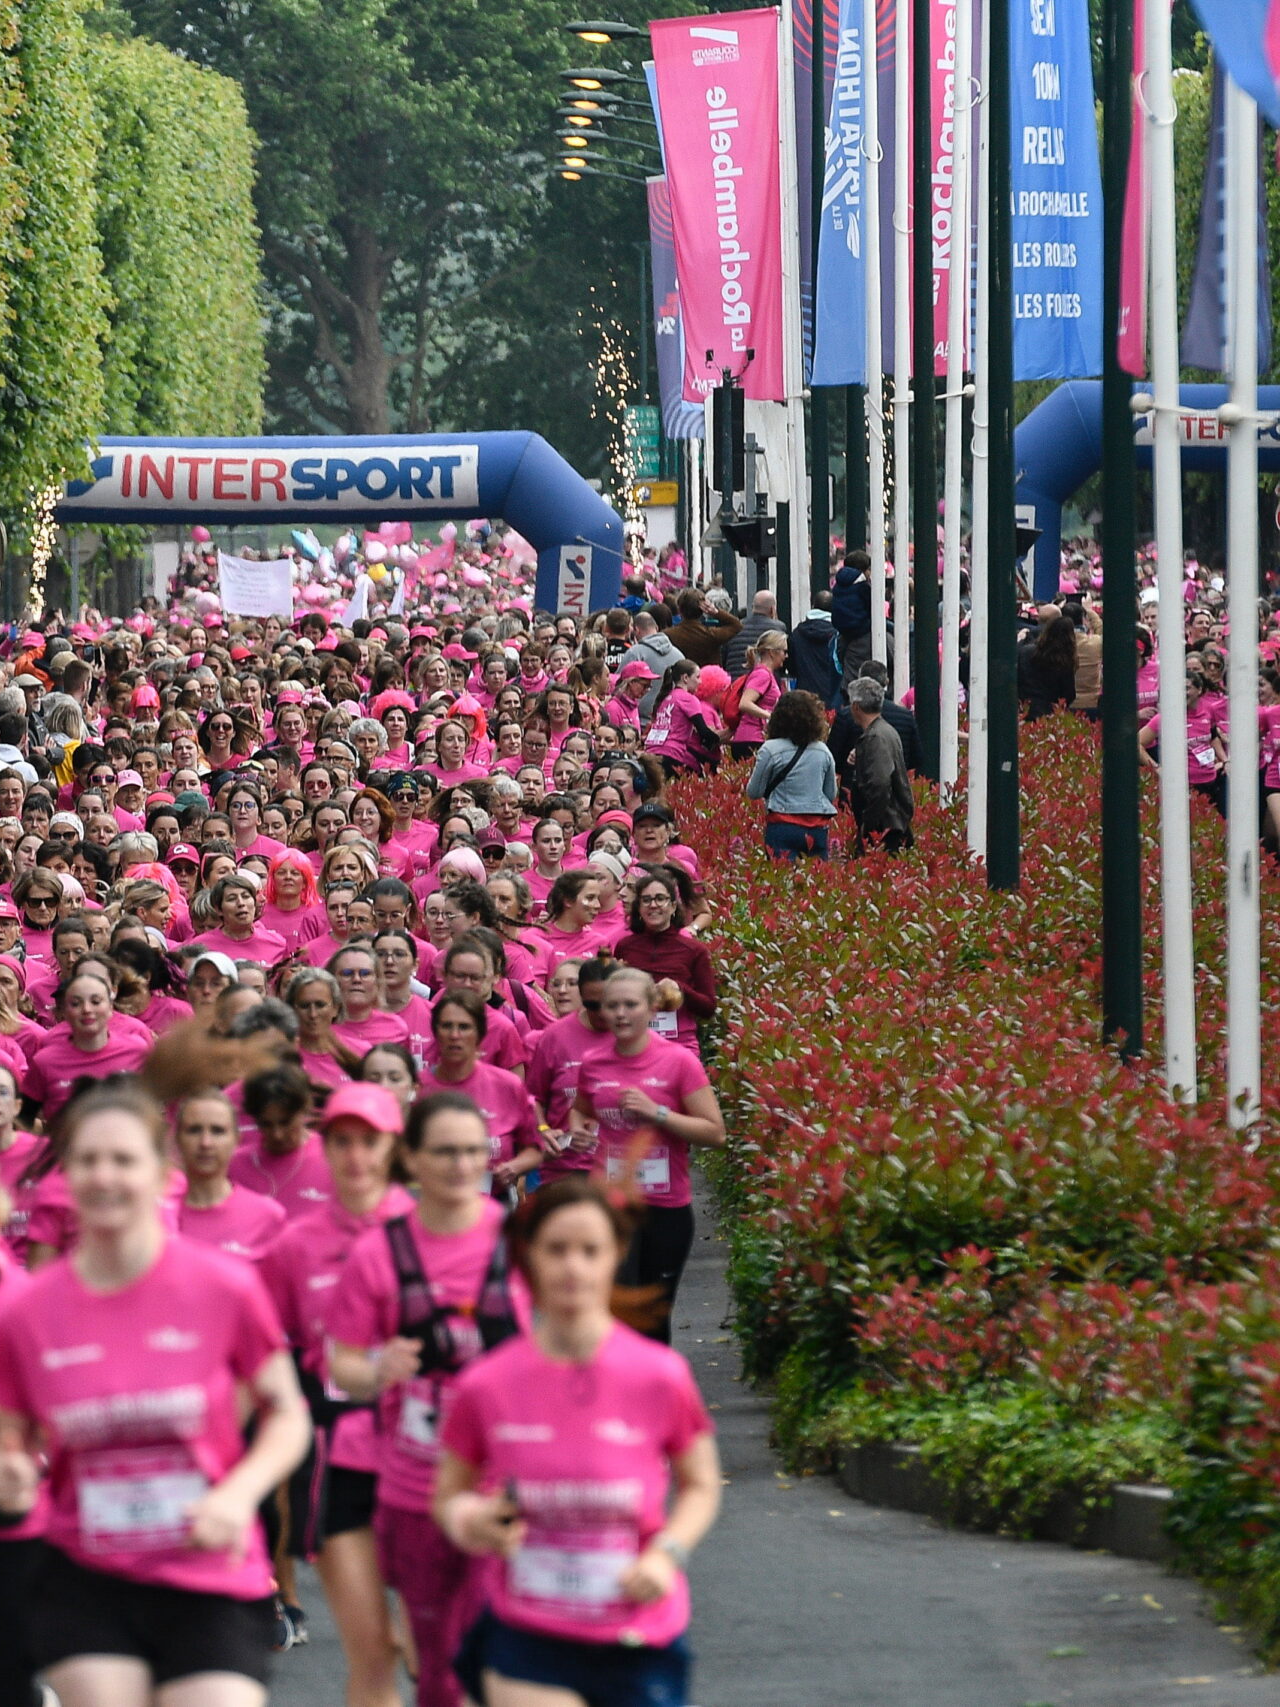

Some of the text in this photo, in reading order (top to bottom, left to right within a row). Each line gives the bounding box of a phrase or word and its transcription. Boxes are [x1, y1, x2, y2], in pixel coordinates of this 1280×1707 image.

[1013, 242, 1042, 268] LES
[1015, 293, 1043, 319] LES
[121, 453, 462, 502] INTERSPORT
